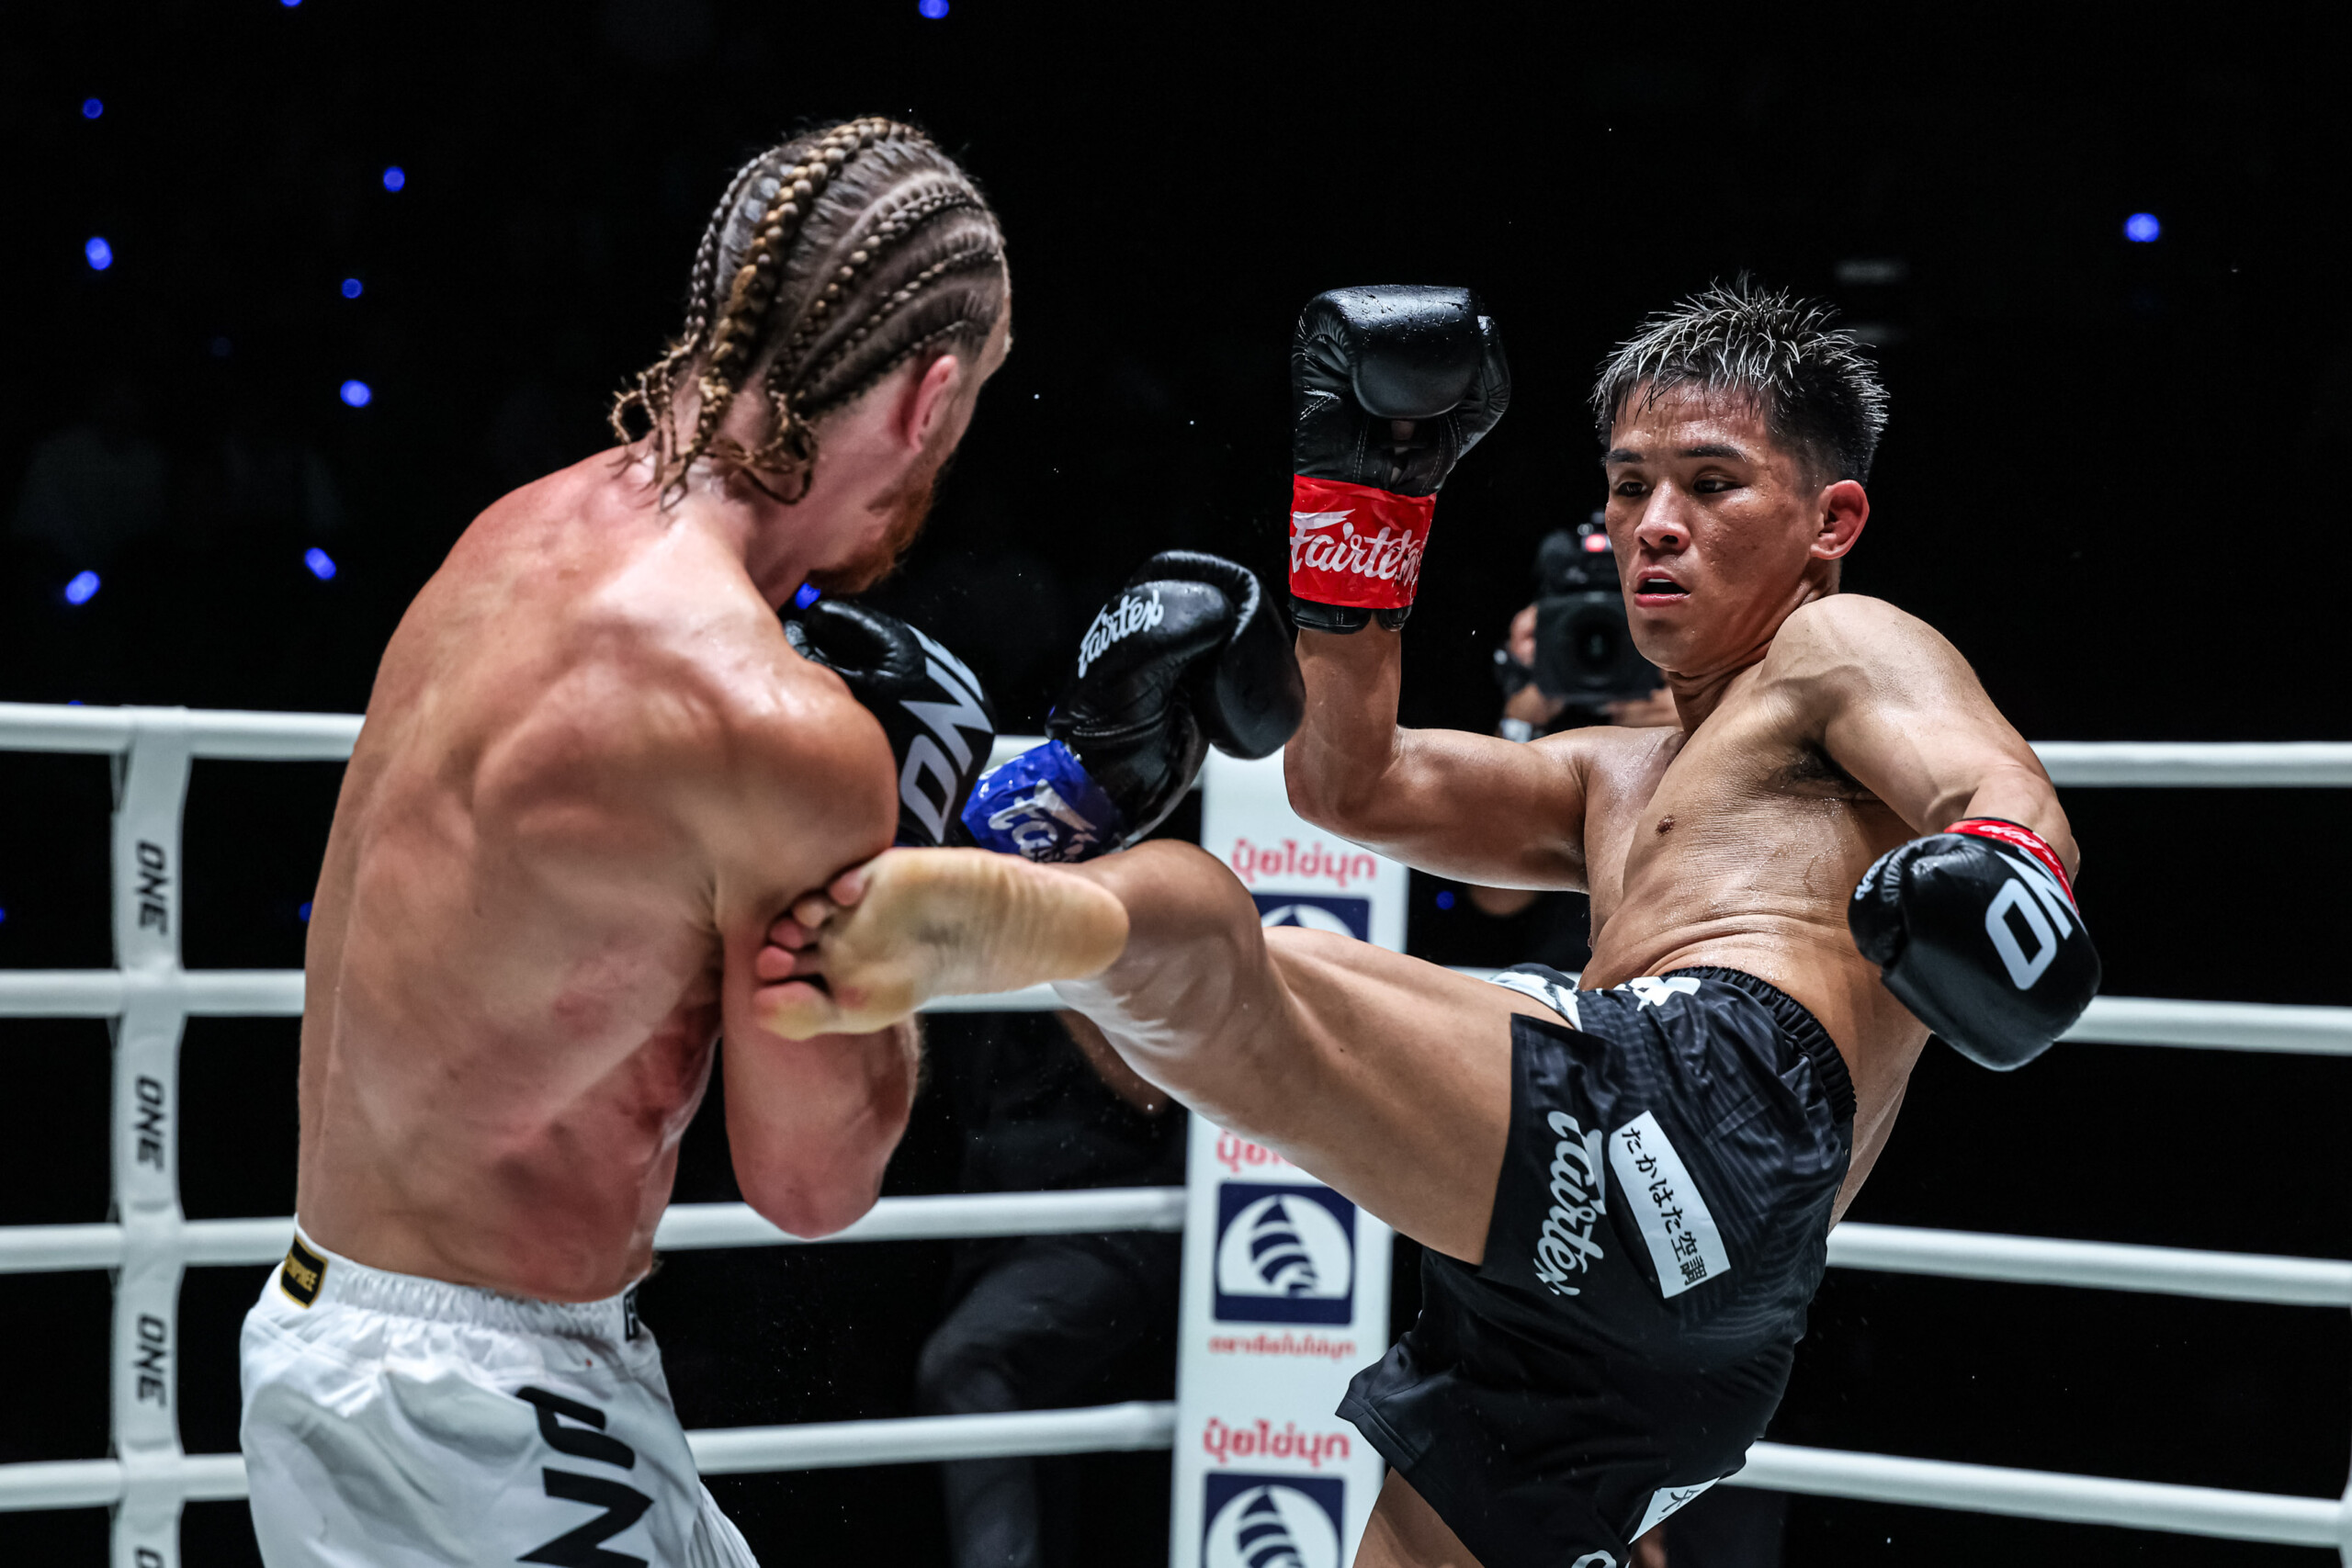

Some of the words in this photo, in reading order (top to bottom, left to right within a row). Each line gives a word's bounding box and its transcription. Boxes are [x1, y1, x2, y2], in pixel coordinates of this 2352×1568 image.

[1078, 589, 1164, 679] Fairtex
[135, 840, 170, 936] ONE
[134, 1075, 166, 1172] ONE
[1622, 1127, 1707, 1286] たかはた空調
[132, 1314, 168, 1407] ONE
[1203, 1416, 1351, 1468] ปุ๋ยไข่มุก
